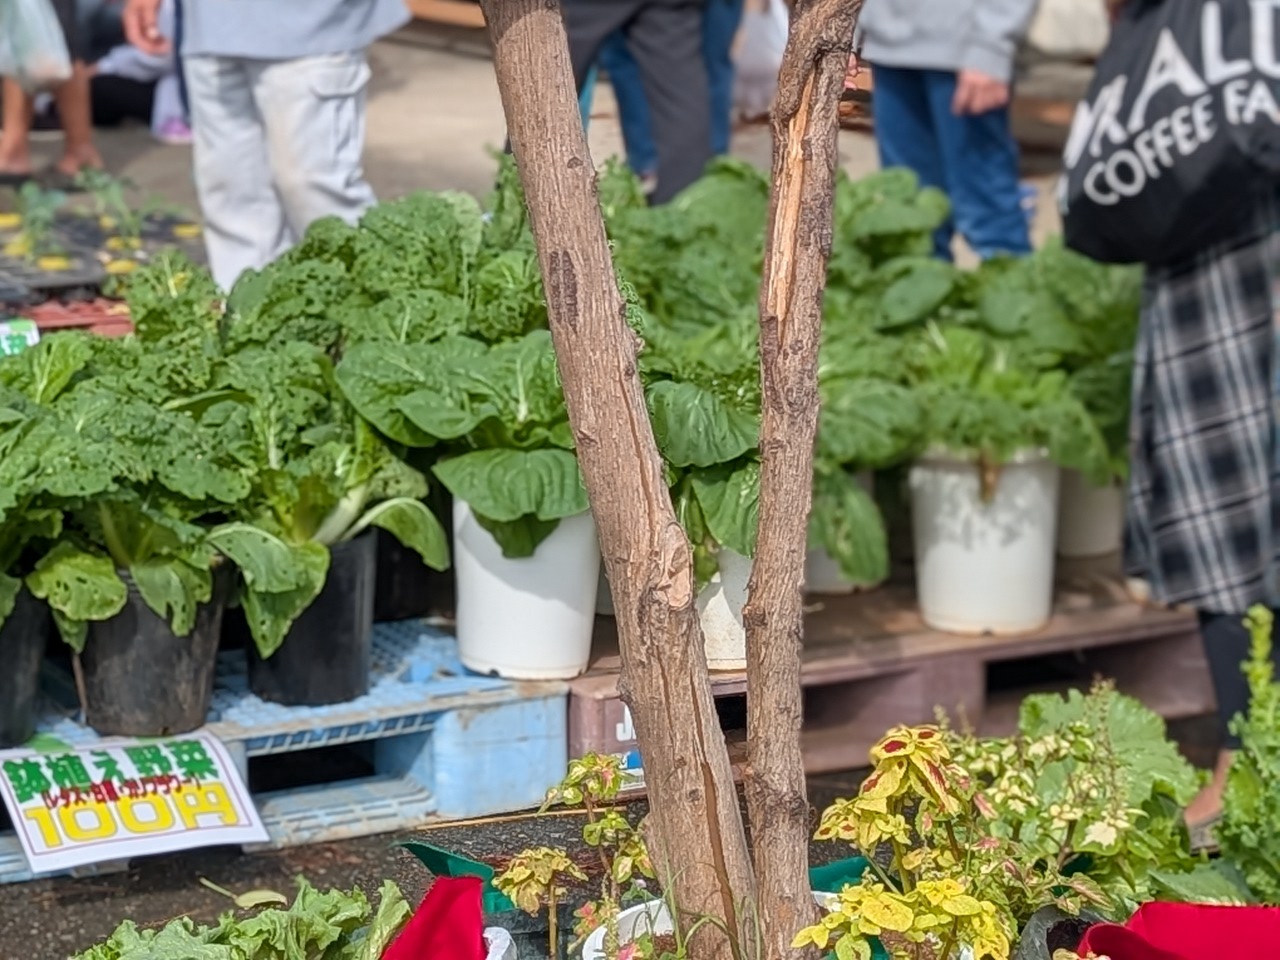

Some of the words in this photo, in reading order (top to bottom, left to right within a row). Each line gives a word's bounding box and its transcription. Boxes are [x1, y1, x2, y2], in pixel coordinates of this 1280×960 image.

[1083, 94, 1216, 205] COFFEE
[2, 740, 219, 803] 鉢植え野菜
[24, 782, 240, 848] 100円
